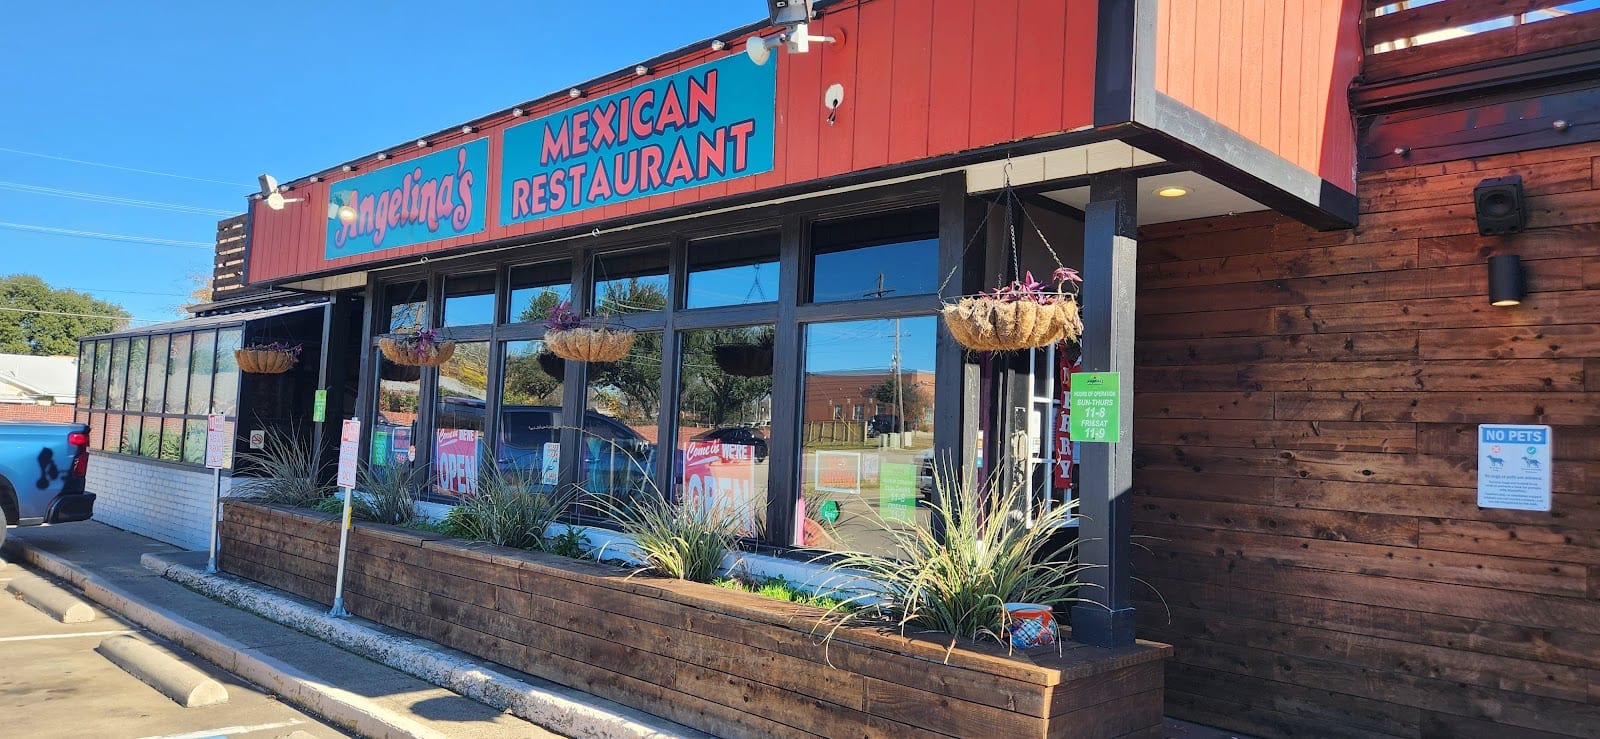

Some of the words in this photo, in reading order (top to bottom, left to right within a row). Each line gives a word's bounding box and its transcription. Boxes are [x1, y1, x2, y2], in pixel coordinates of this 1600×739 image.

[539, 69, 718, 168] MEXICAN
[511, 119, 756, 219] RESTAURANT
[334, 147, 474, 249] Angelina's
[1085, 407, 1106, 418] 11-8
[1085, 428, 1106, 438] 11-9
[687, 441, 710, 461] Come
[1486, 430, 1504, 441] NO
[1508, 430, 1542, 442] PETS
[439, 452, 476, 496] OPEN
[688, 473, 752, 533] OPEN
